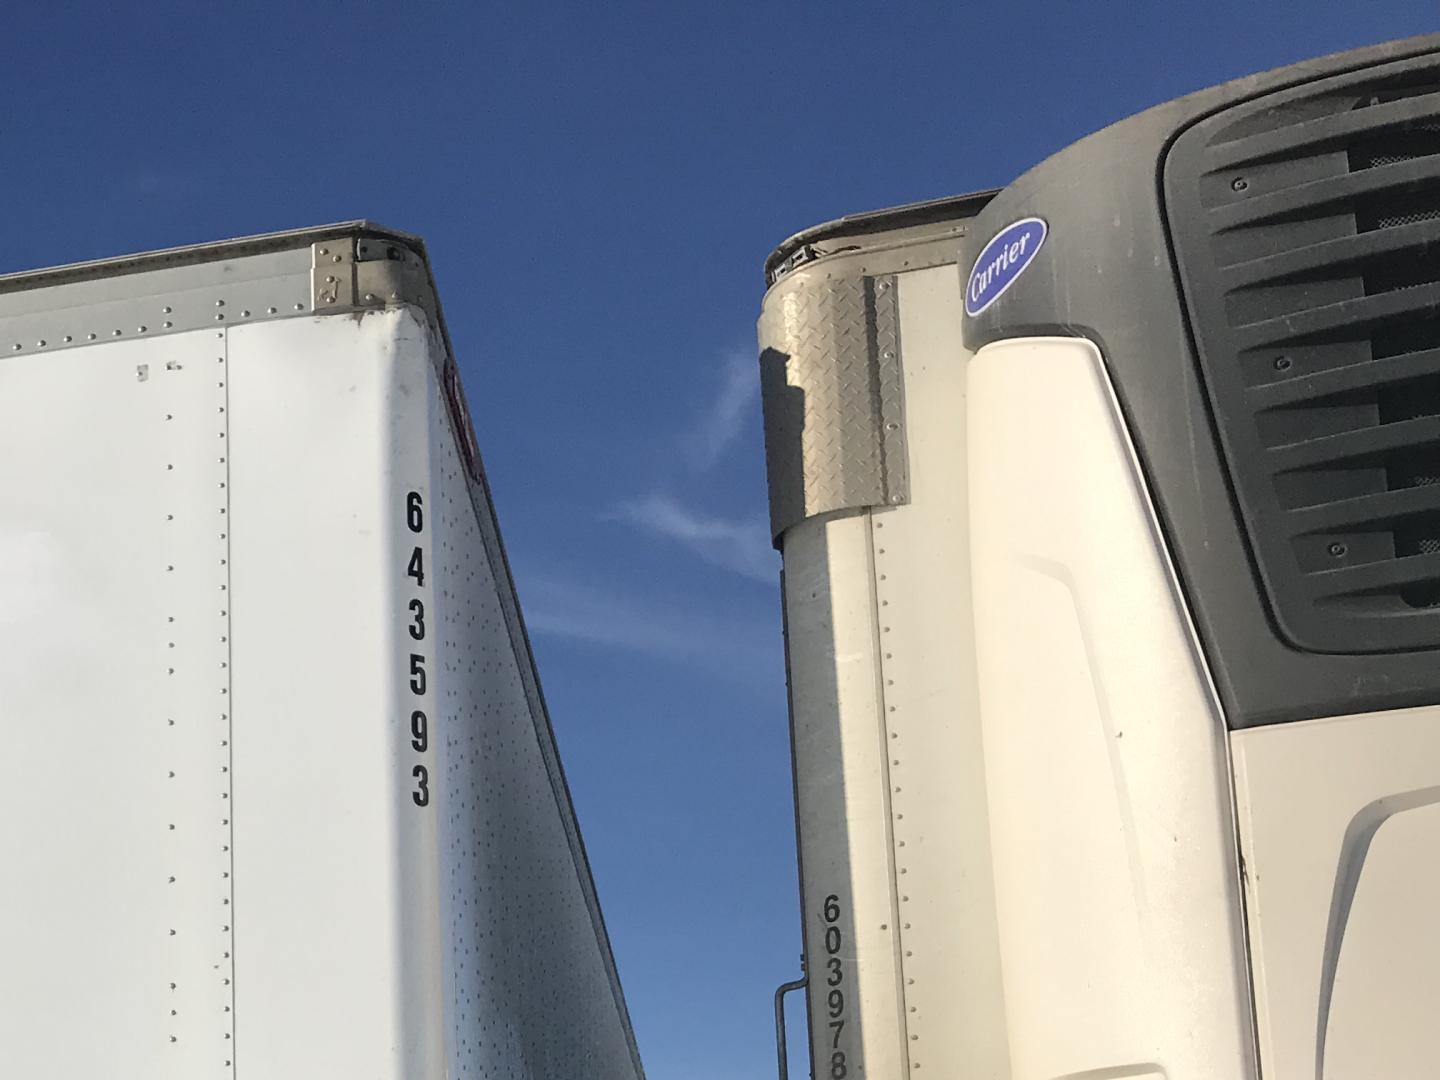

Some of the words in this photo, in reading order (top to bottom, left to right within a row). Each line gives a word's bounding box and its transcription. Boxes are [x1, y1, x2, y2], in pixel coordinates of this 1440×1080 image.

[971, 231, 1031, 303] Carrier
[406, 491, 430, 809] 643593
[824, 894, 847, 1080] 603978
